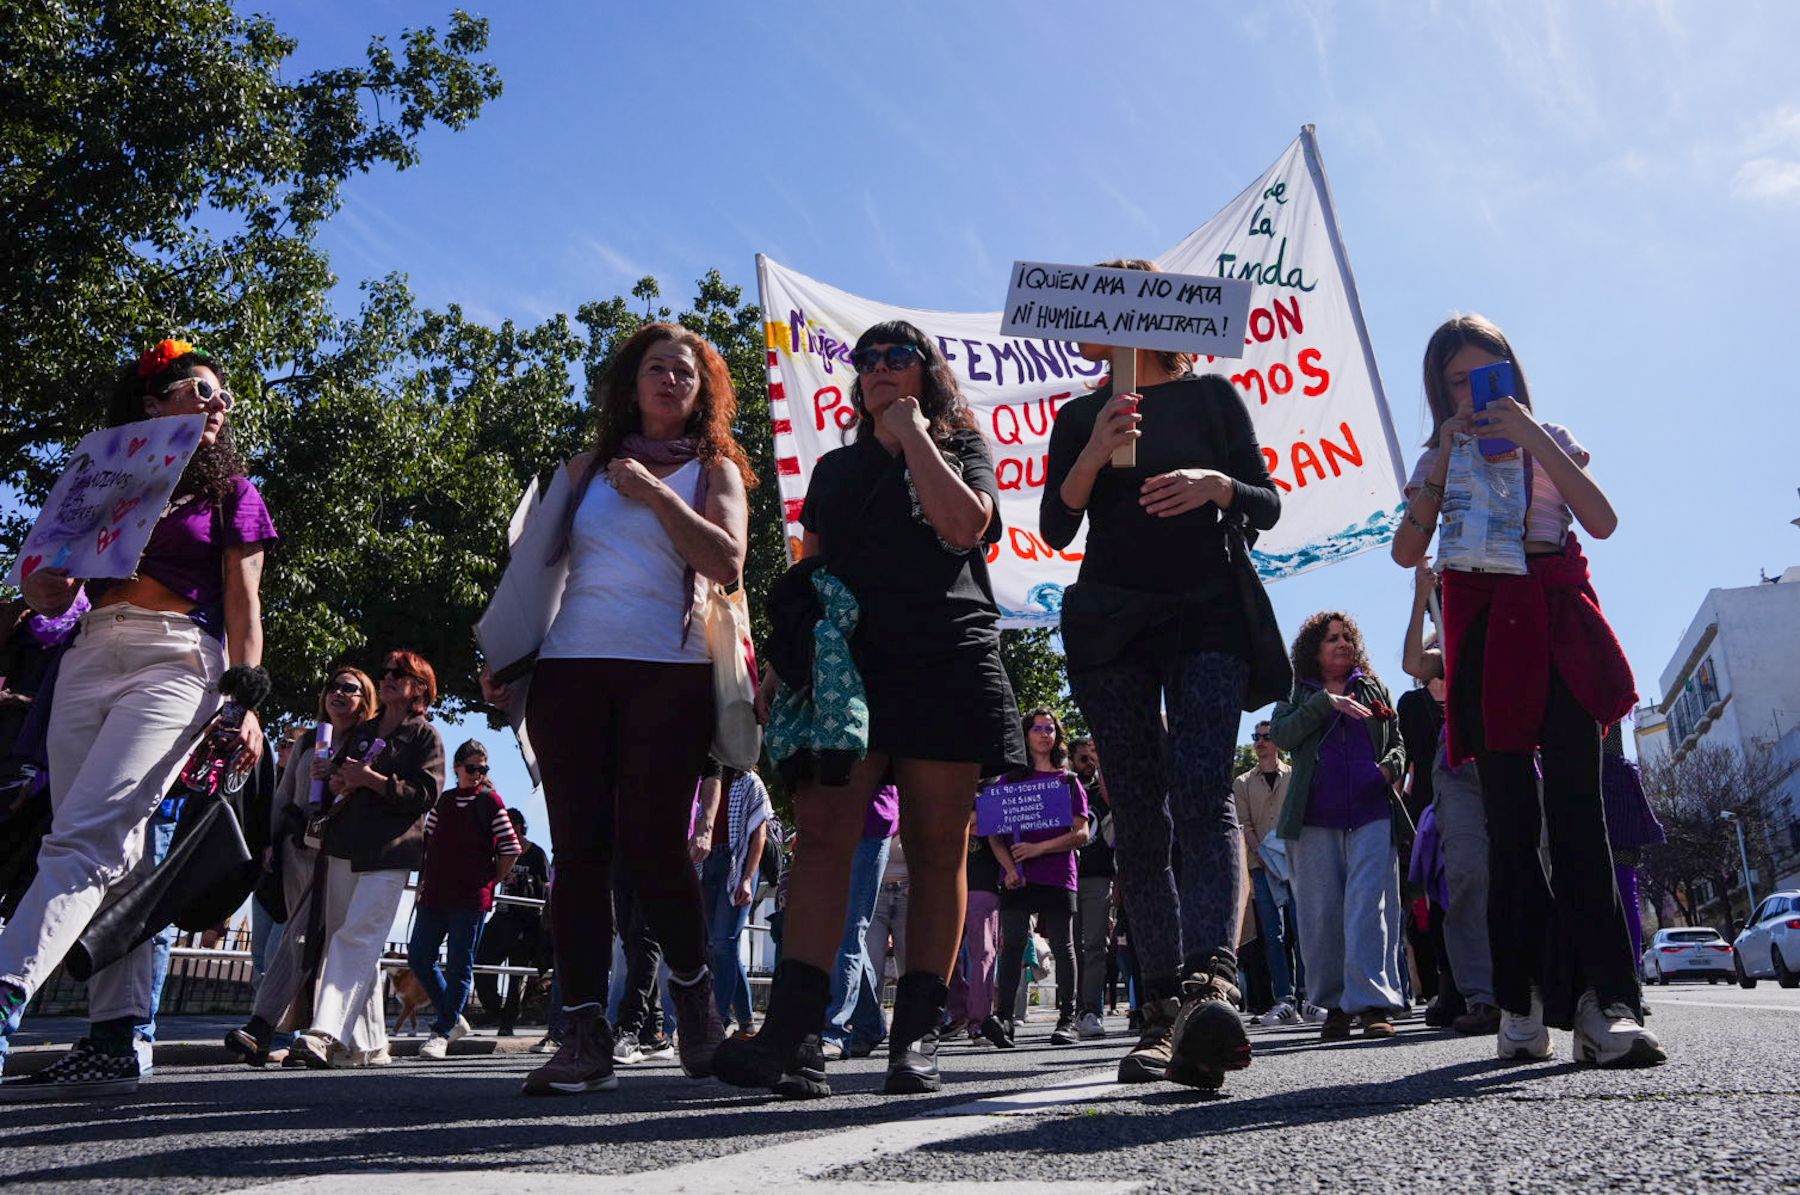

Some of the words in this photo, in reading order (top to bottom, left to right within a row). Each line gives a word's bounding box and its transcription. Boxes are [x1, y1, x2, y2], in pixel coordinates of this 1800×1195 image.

[1263, 175, 1289, 205] de
[1093, 276, 1125, 295] AMA
[1138, 278, 1172, 298] NO
[1176, 283, 1222, 305] MATA
[1245, 296, 1304, 345] ON
